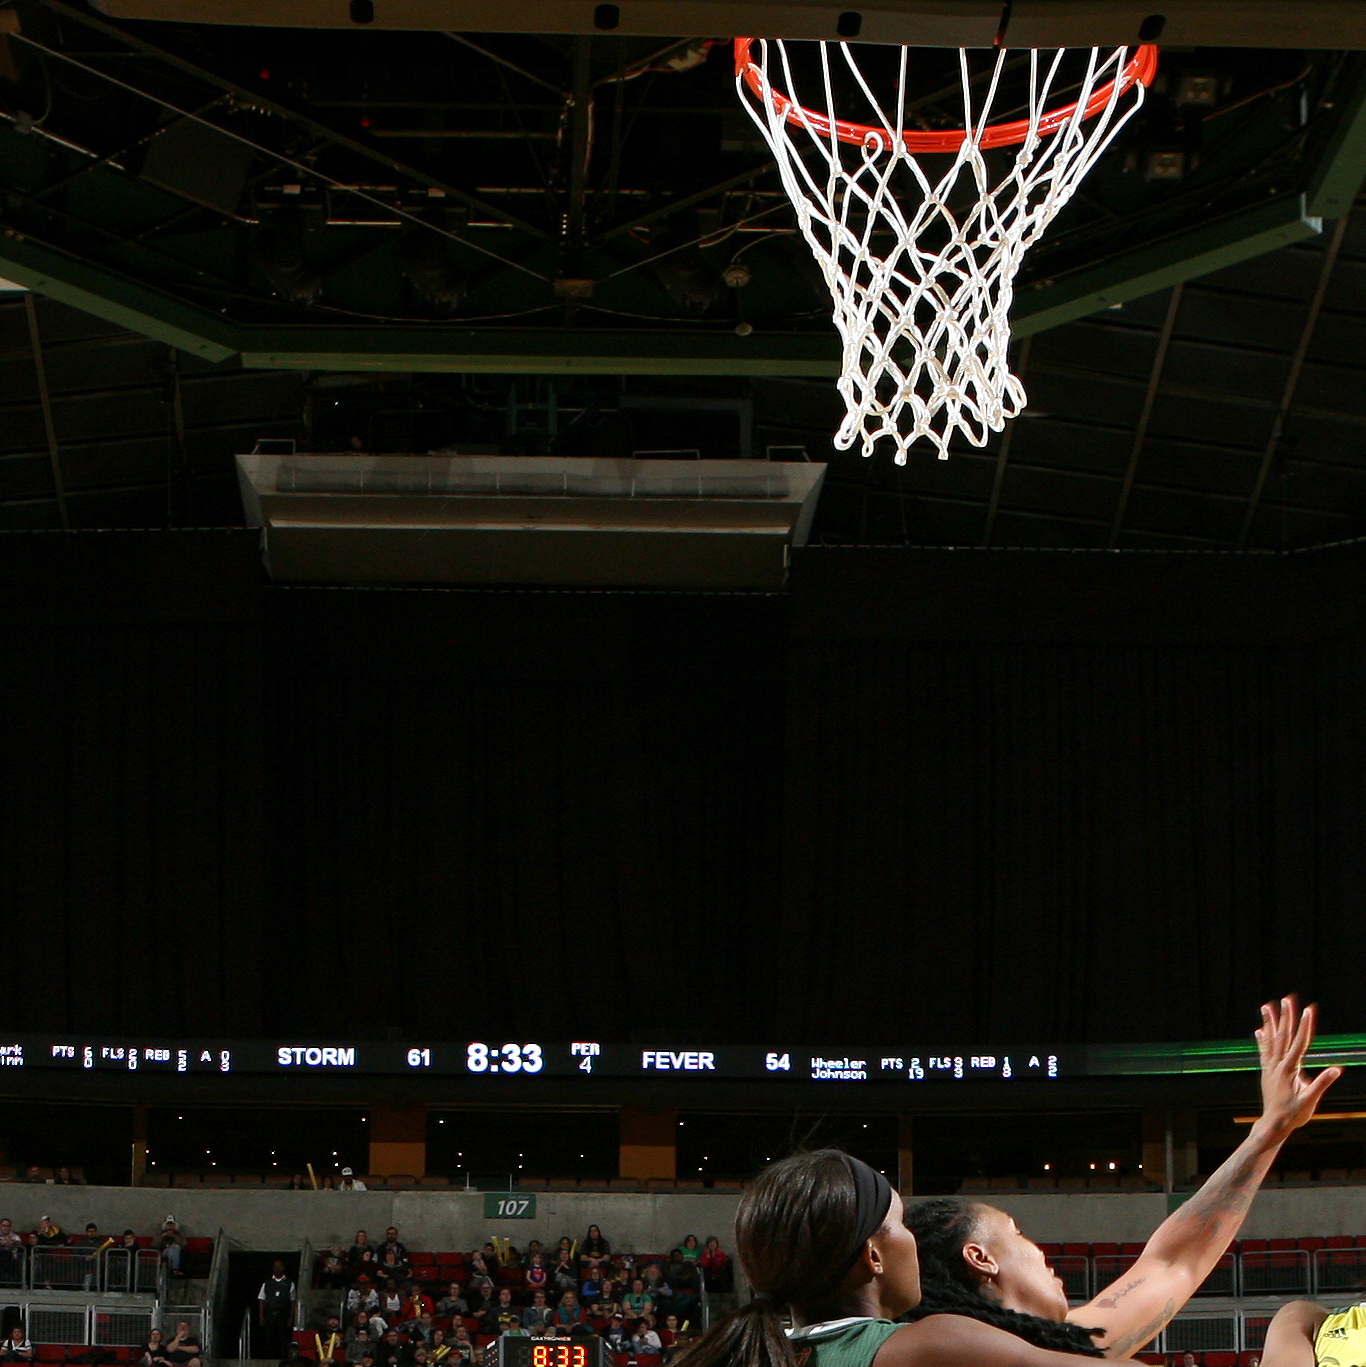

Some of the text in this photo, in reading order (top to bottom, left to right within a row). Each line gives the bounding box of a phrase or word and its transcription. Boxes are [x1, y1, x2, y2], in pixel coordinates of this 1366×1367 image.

[51, 1045, 76, 1058] PTS
[200, 1050, 212, 1062] A
[571, 1042, 601, 1056] PER
[277, 1042, 544, 1074] STORM 61 8:33
[578, 1056, 592, 1074] 4
[641, 1050, 791, 1072] FEVER 54
[811, 1057, 868, 1069] Wheeler
[880, 1057, 904, 1070] PTS
[910, 1057, 921, 1069] 2
[929, 1057, 953, 1070] FLS
[970, 1055, 997, 1069] REB
[1028, 1055, 1040, 1068] A
[811, 1068, 868, 1080] Johnson
[908, 1068, 925, 1080] 19
[497, 1199, 530, 1216] 107
